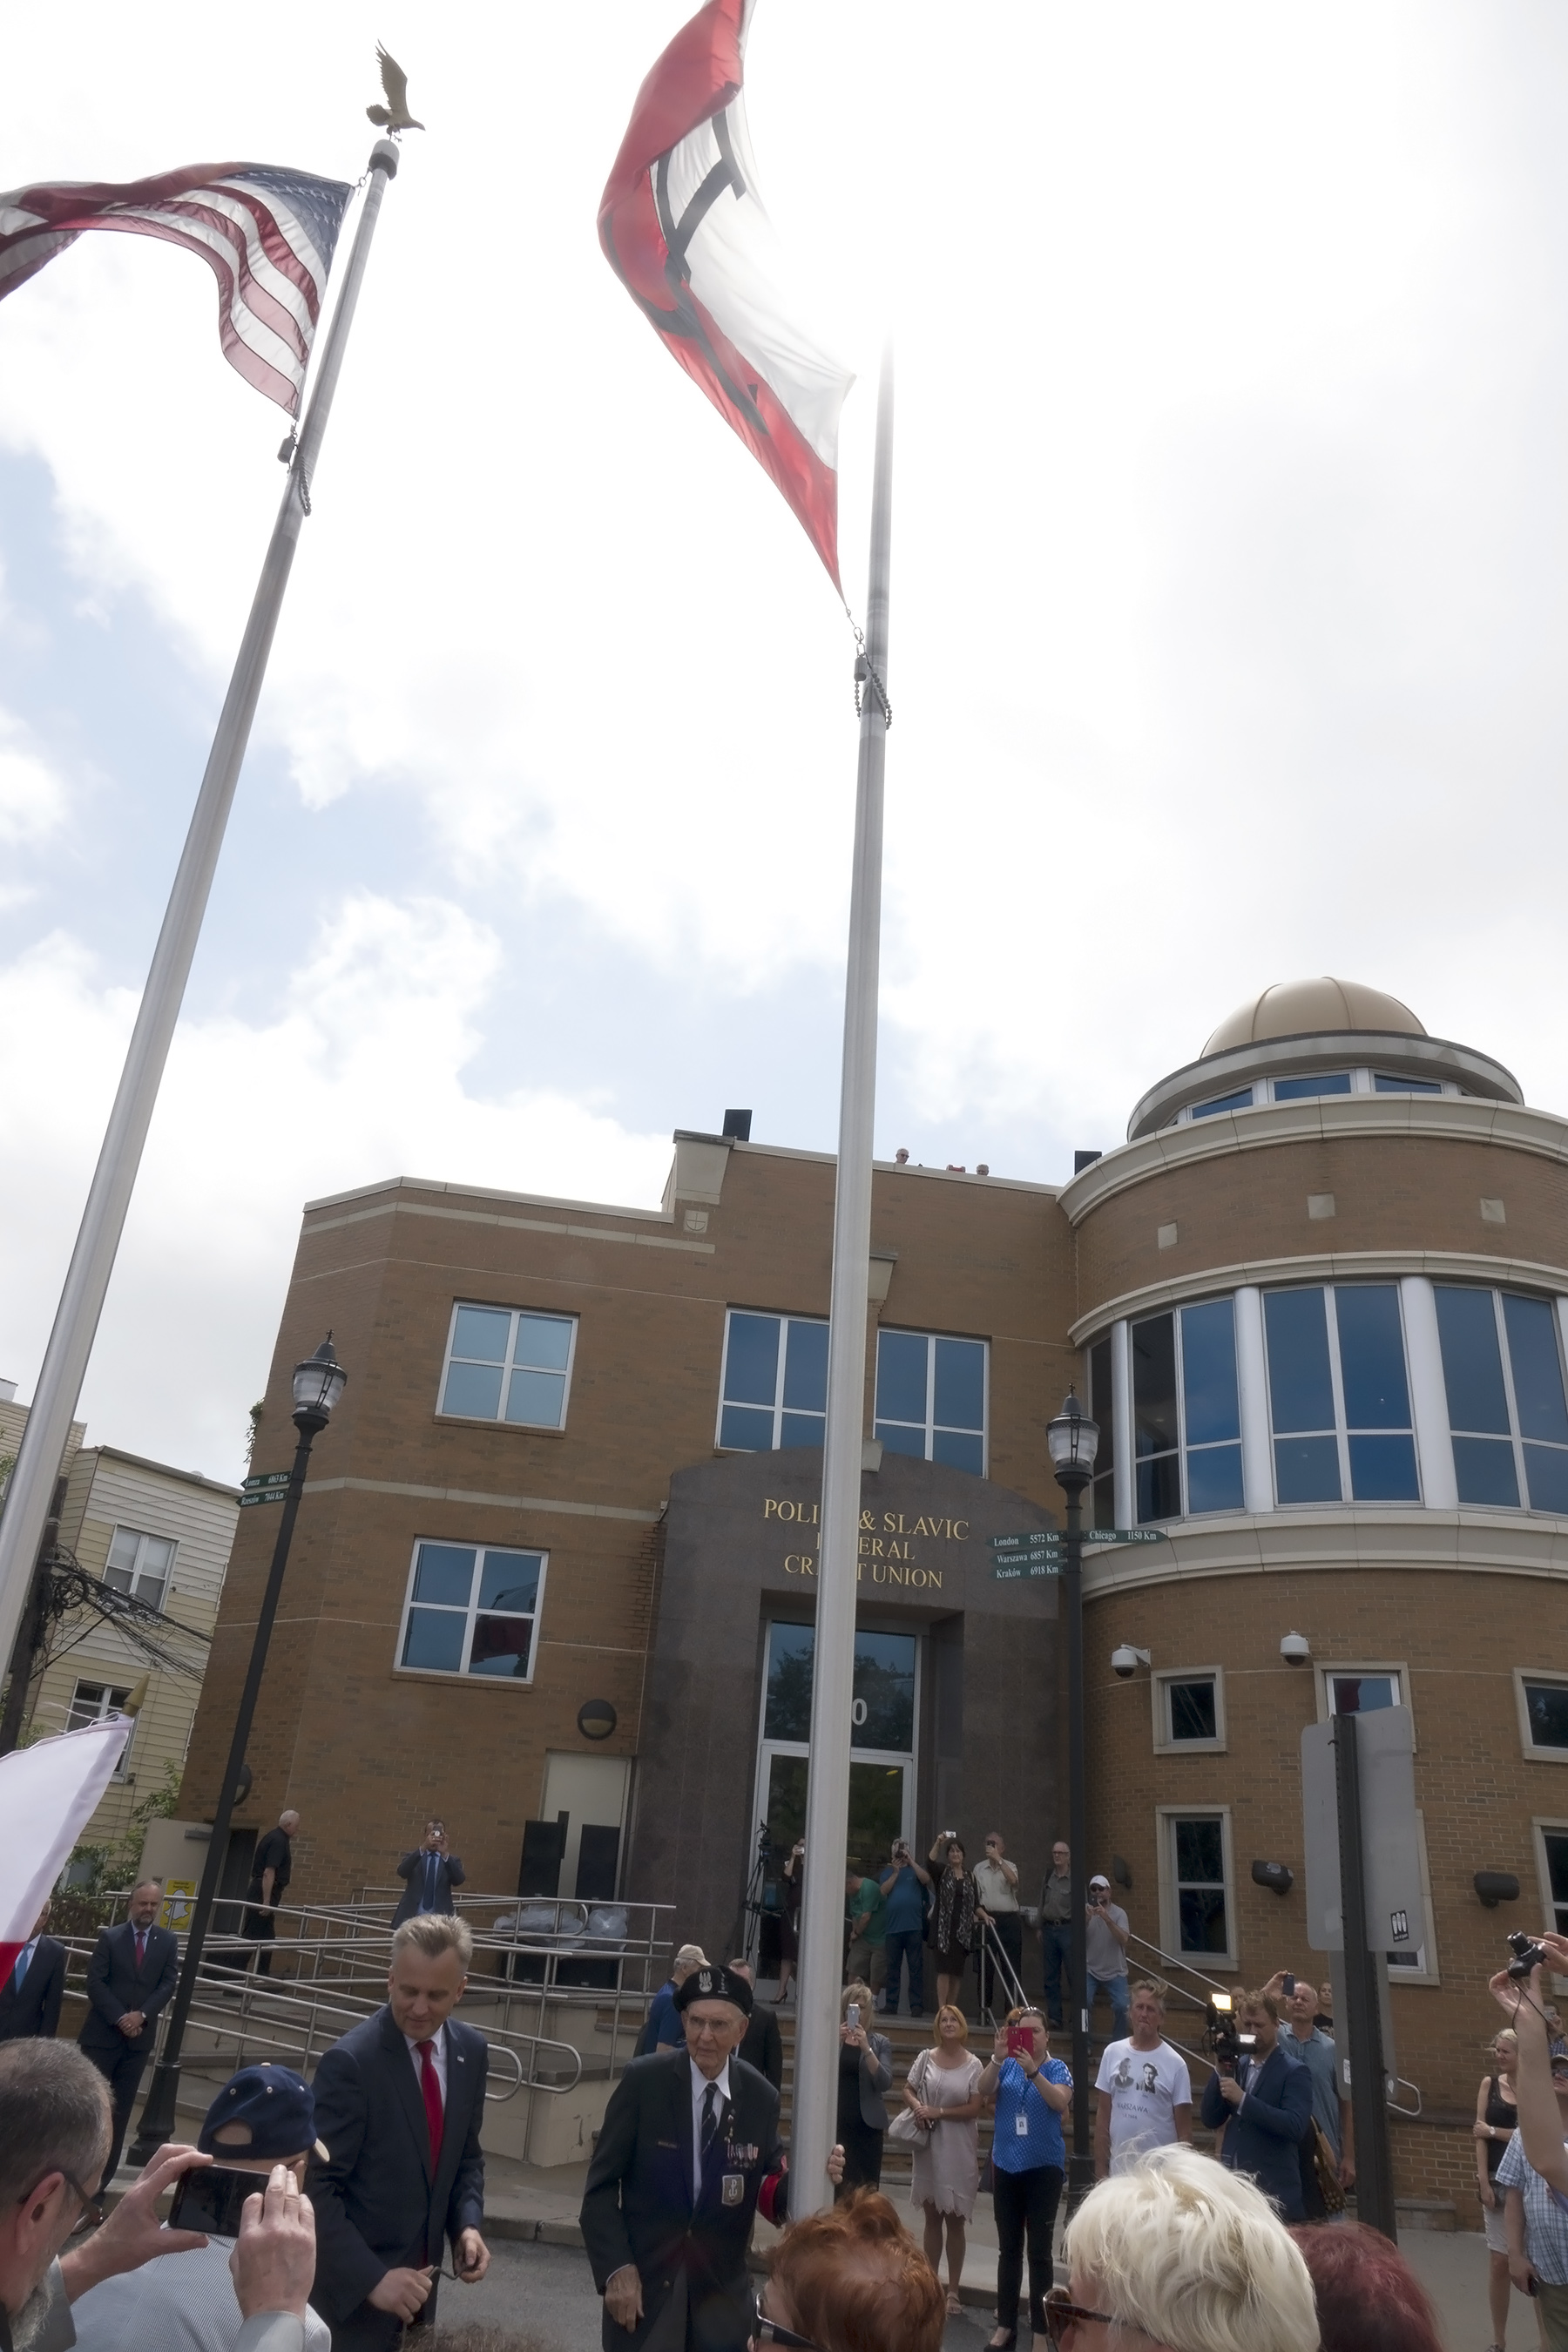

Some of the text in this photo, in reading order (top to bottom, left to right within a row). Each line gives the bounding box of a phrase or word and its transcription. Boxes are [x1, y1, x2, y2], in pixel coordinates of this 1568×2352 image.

[279, 1473, 287, 1482] Km
[264, 1492, 275, 1501] 7044
[275, 1491, 284, 1500] Km
[763, 1498, 969, 1541] POLI & SLAVIC
[994, 1532, 1059, 1547] London 5572 Km
[1089, 1530, 1157, 1542] Chicago 1150 Km
[815, 1531, 915, 1560] ERAL
[997, 1549, 1058, 1564] Warszawa 6857 Km
[784, 1554, 943, 1589] CRT UNION
[997, 1565, 1059, 1578] Kraków 6918 Km
